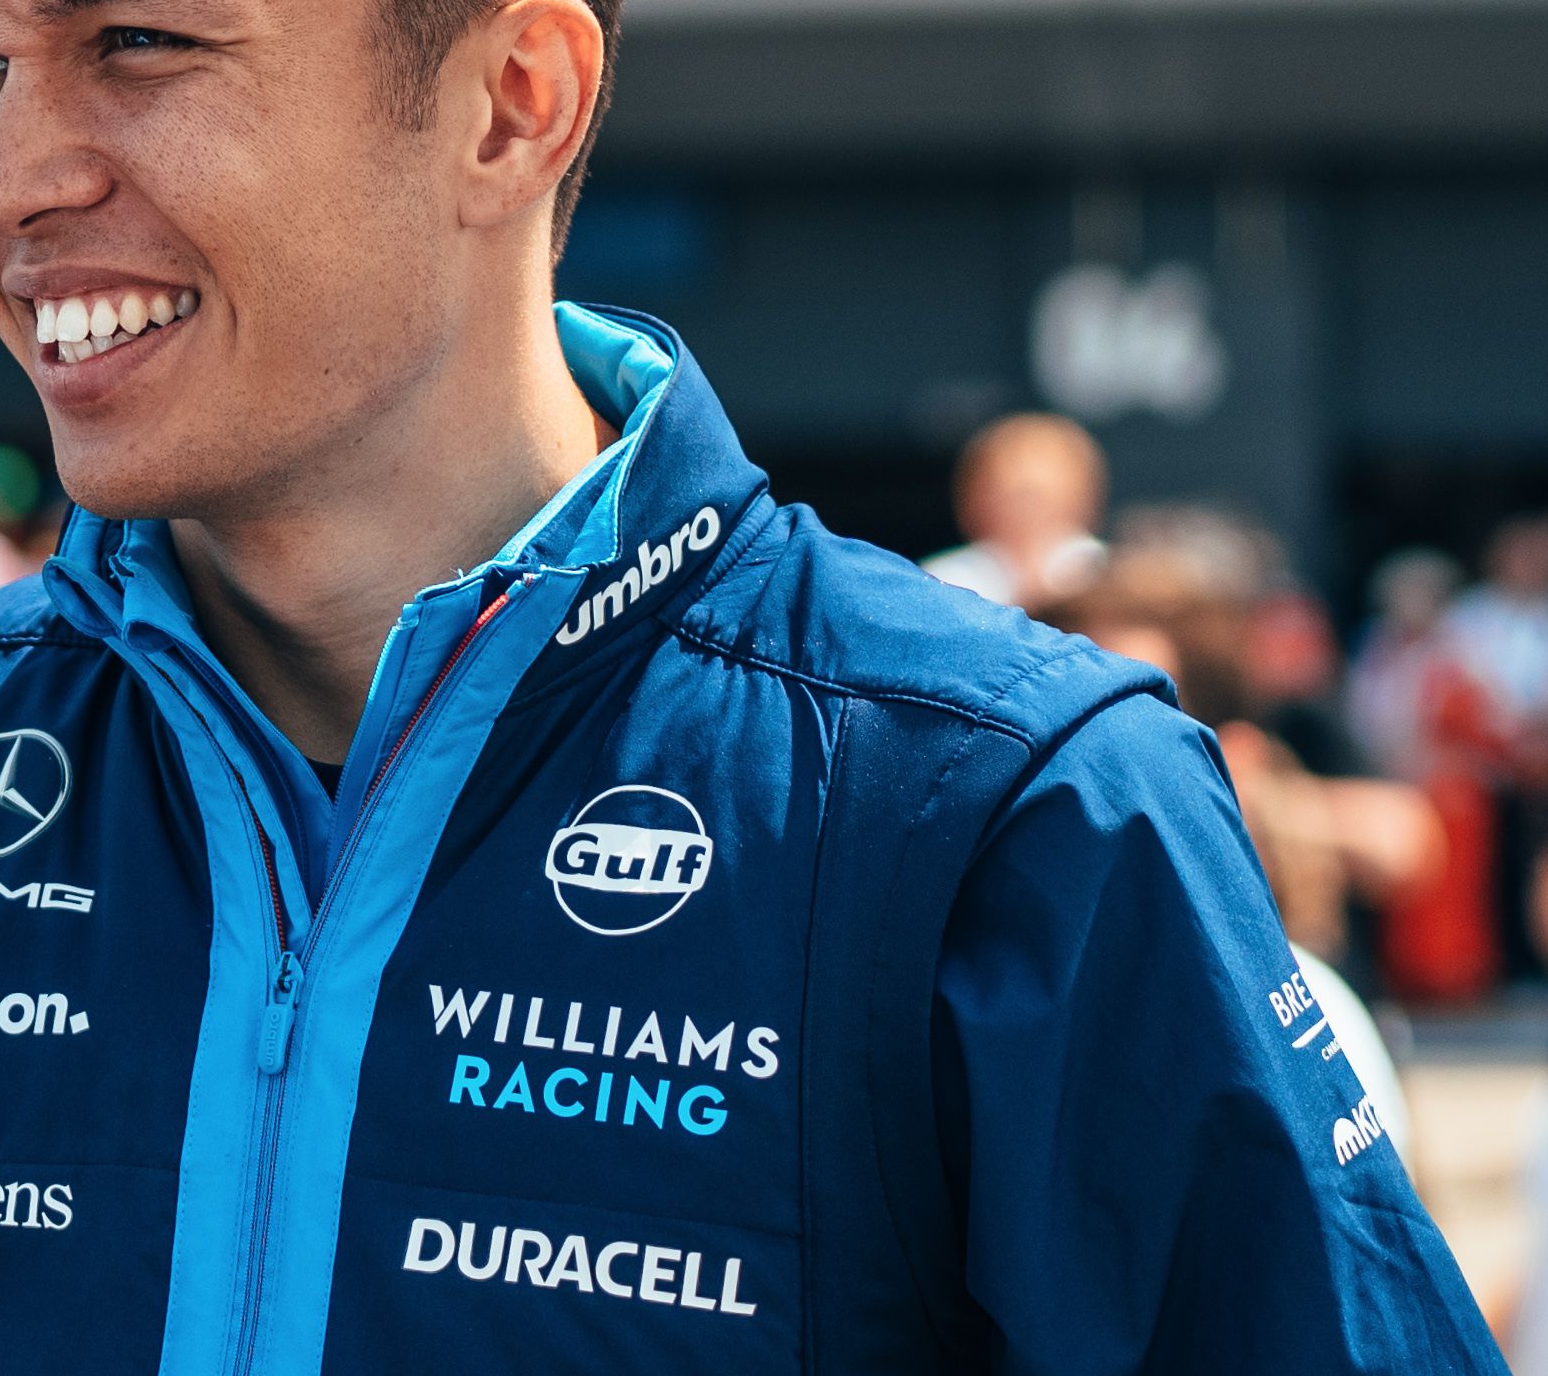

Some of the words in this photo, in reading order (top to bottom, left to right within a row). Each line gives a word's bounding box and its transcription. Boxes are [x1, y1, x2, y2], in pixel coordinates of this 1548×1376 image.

[554, 505, 721, 647] umbro
[551, 831, 708, 886] Gulf
[428, 983, 781, 1080] WILLIAMS
[448, 1053, 729, 1137] RACING
[402, 1216, 759, 1317] DURACELL
